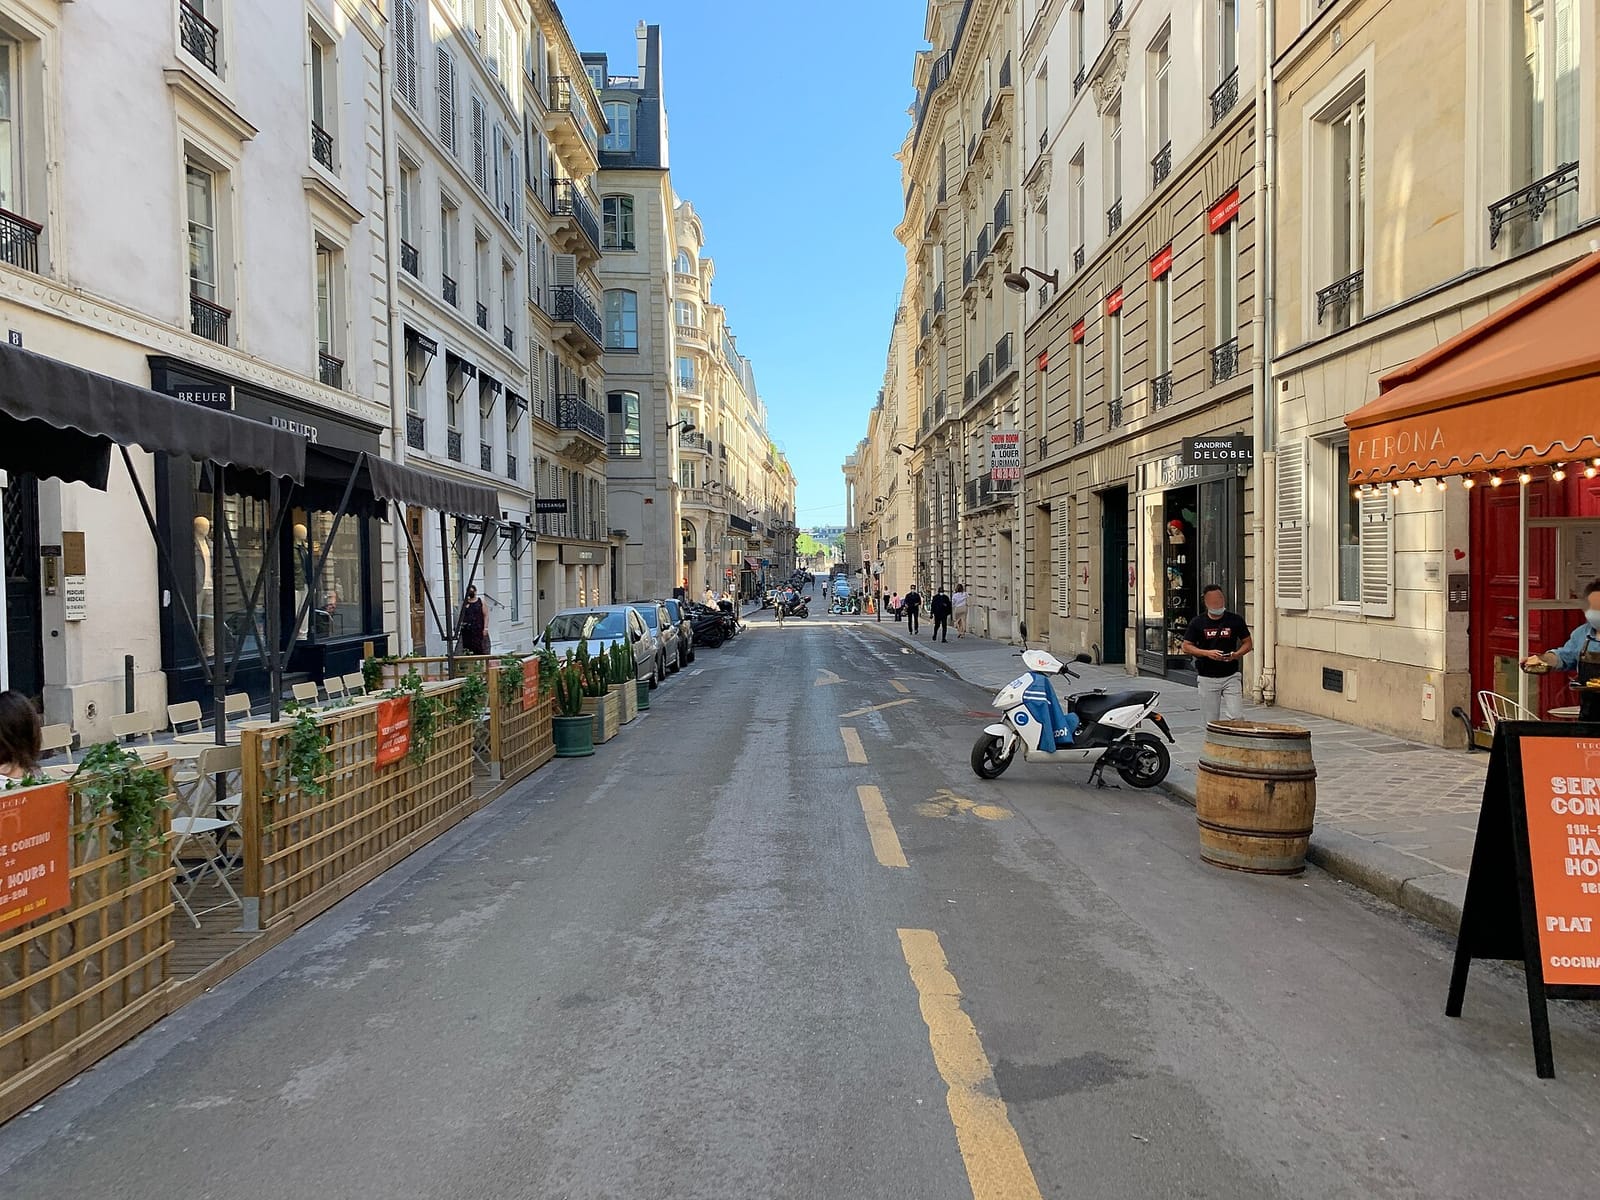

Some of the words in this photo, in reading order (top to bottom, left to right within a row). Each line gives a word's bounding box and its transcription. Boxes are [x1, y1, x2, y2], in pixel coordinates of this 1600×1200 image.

[12, 332, 19, 345] 8
[178, 392, 226, 402] BREUER
[1193, 441, 1233, 450] SANDRINE
[1358, 426, 1446, 460] FERONA
[991, 450, 996, 458] A
[999, 450, 1019, 458] LOUER
[1193, 450, 1253, 460] DELOBEL
[11, 832, 51, 852] CONTINU
[1564, 858, 1600, 877] HO
[8, 865, 46, 888] HOURS
[1545, 916, 1593, 932] PLAT
